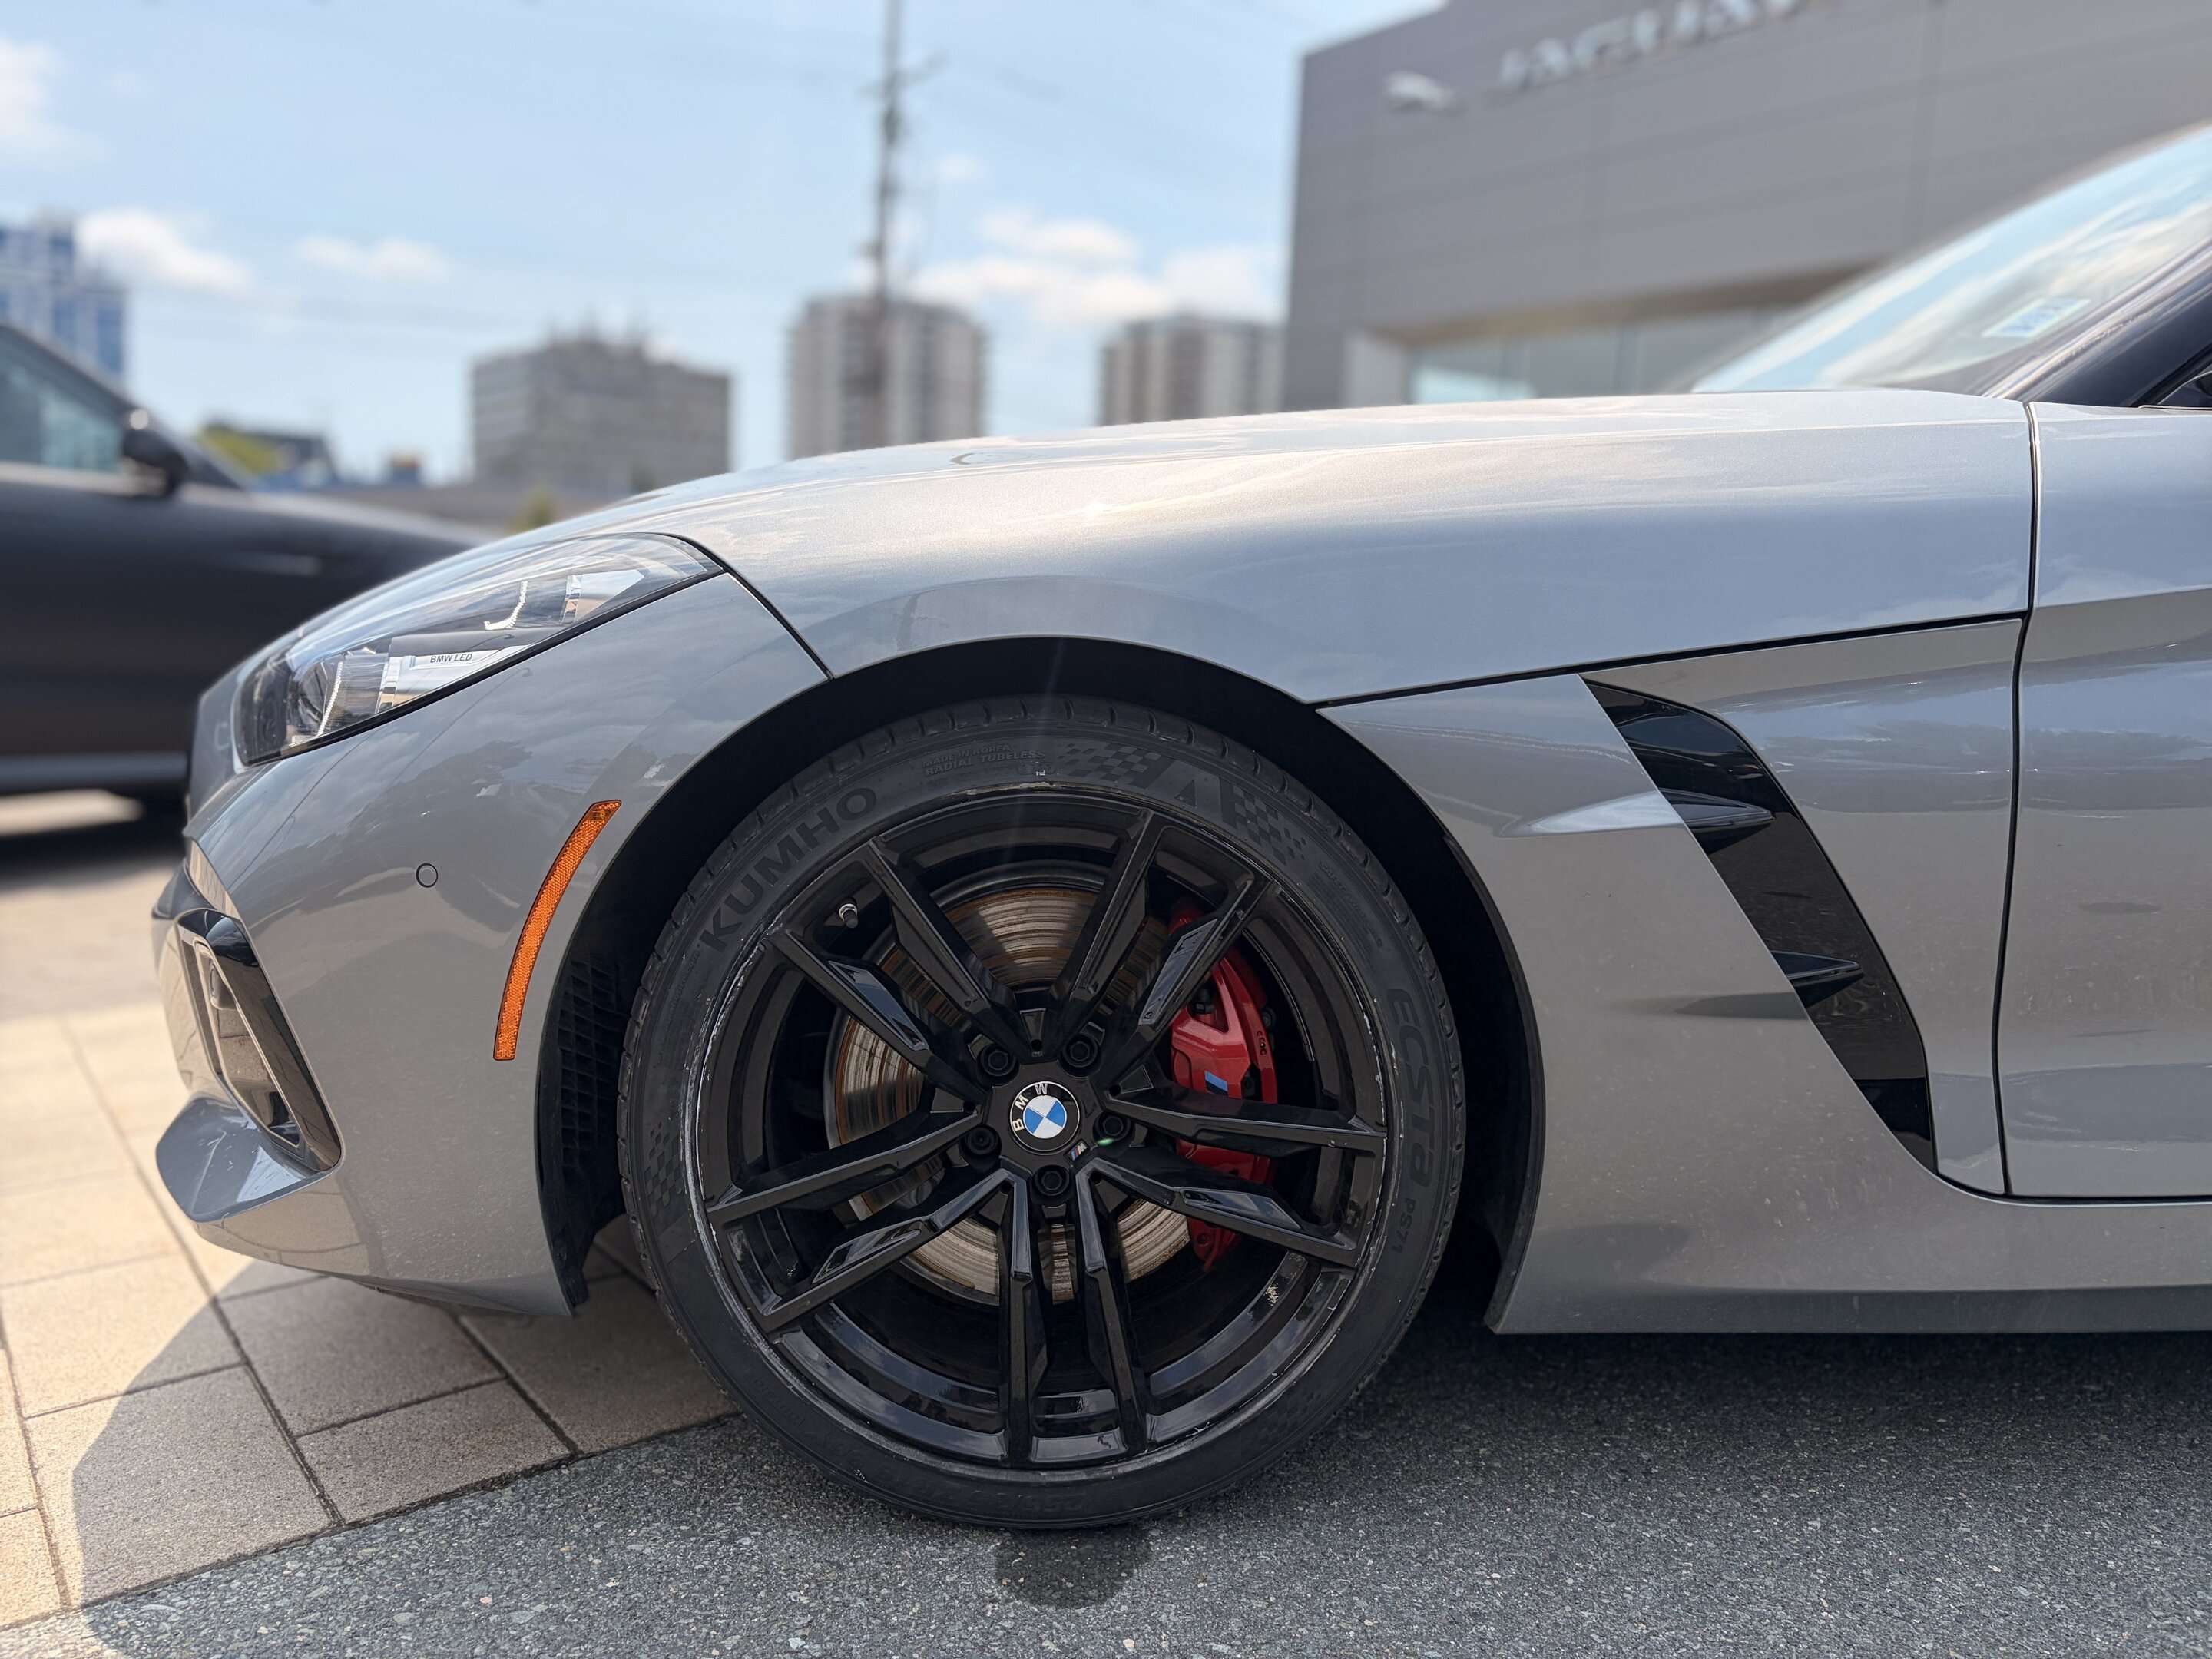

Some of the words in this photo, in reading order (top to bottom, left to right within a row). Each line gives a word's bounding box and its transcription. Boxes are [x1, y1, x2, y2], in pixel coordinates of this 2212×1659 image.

[430, 654, 452, 664] BMW
[453, 653, 473, 662] LED
[922, 755, 955, 768] MADE
[958, 749, 969, 758] IN
[972, 743, 1011, 757] KOREA
[925, 757, 973, 776] RADIAL
[979, 750, 1046, 763] TUBELESS
[700, 787, 877, 953] KUMHO
[1012, 1082, 1048, 1132] BMW
[1389, 1197, 1416, 1253] PS71
